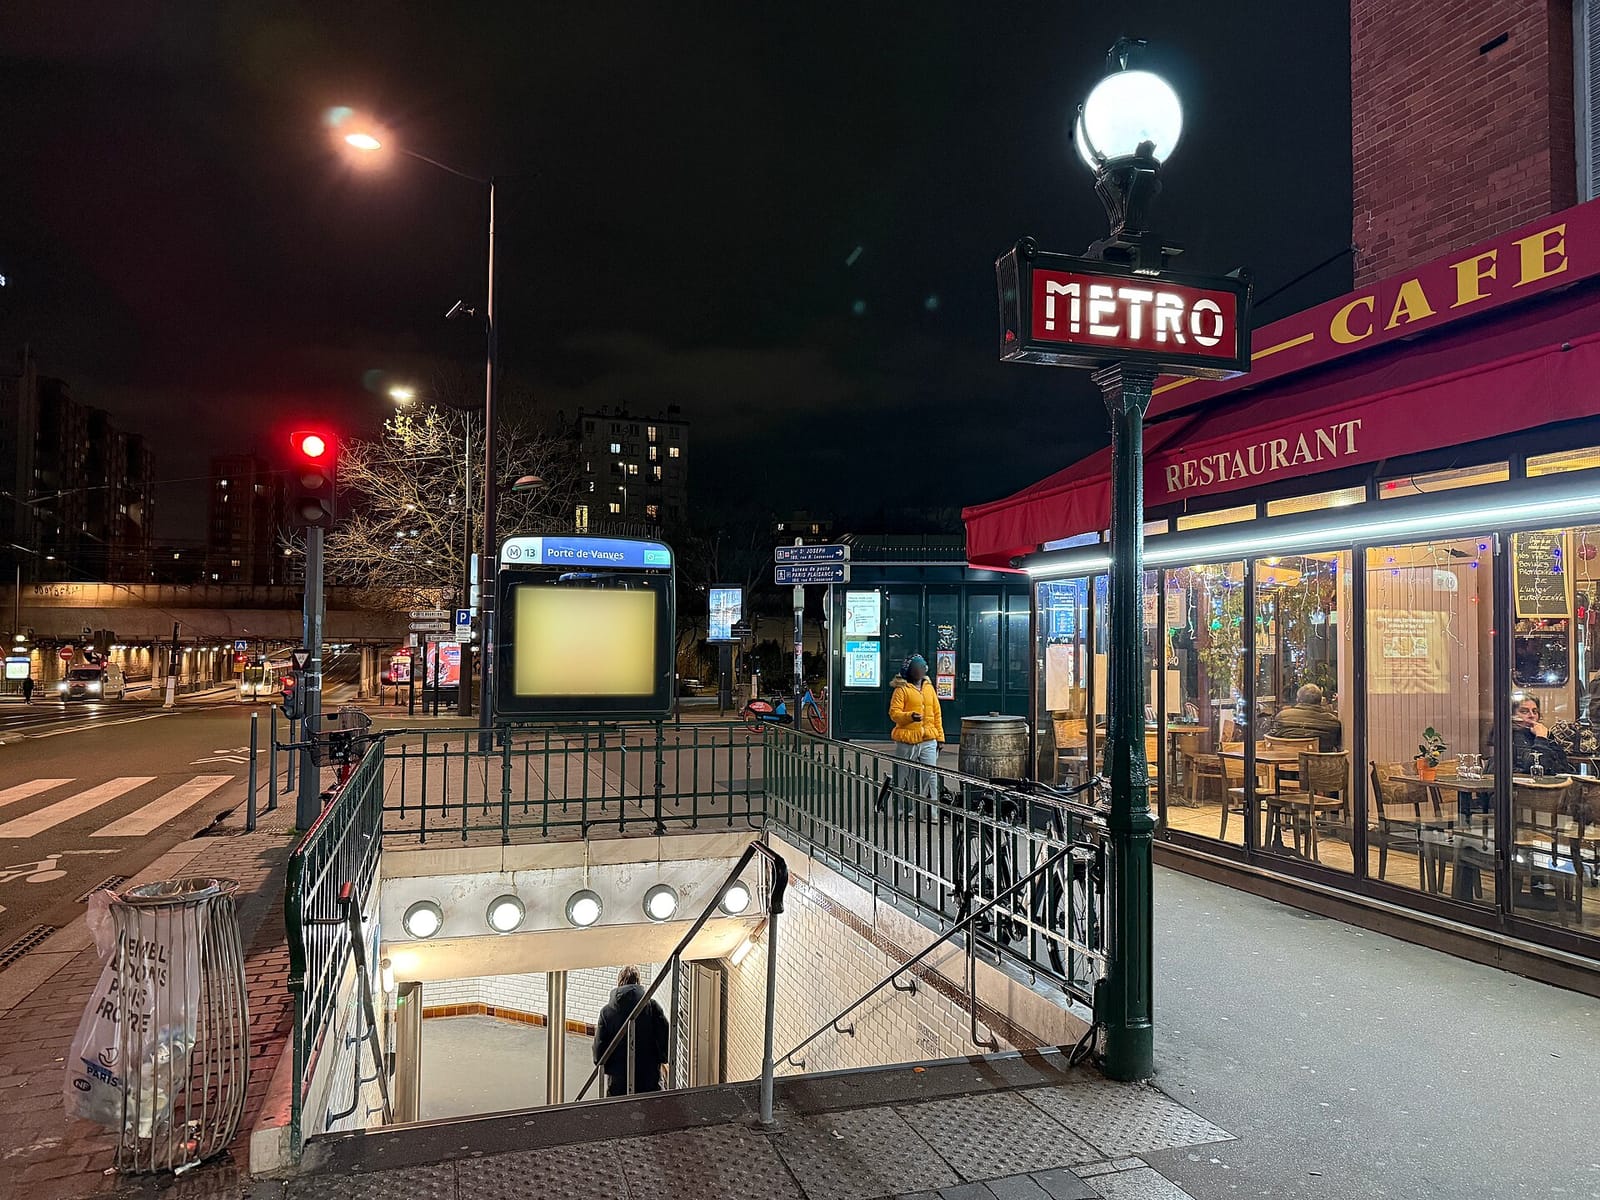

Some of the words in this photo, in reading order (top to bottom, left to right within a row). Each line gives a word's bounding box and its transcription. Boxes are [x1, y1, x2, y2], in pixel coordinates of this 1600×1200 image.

[1329, 223, 1568, 344] CAFE
[1045, 280, 1223, 347] METRO
[1164, 419, 1361, 494] RESTAURANT
[524, 548, 536, 558] 13
[547, 548, 574, 558] Porte
[576, 549, 588, 558] de
[591, 550, 625, 560] Vanves
[460, 612, 467, 624] P
[87, 1066, 119, 1087] PARIS
